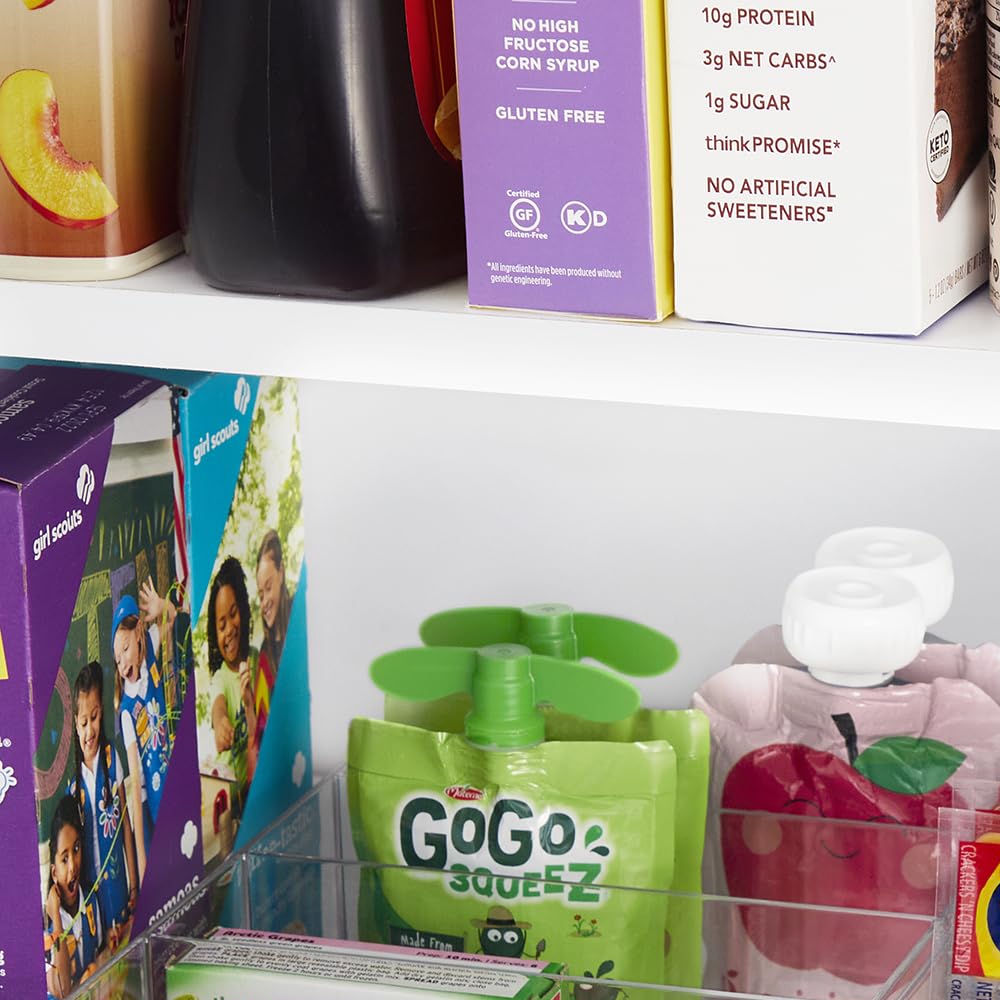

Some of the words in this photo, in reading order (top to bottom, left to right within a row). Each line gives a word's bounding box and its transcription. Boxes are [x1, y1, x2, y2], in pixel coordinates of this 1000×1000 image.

[512, 18, 536, 32] NO
[538, 19, 579, 33] HIGH
[702, 7, 732, 29] 10g
[737, 9, 815, 28] PROTEIN
[504, 37, 589, 53] FRUCTOSE
[496, 56, 542, 71] CORN
[546, 58, 599, 73] SYRUP
[703, 50, 724, 70] 3g
[729, 51, 764, 68] NET
[705, 92, 725, 112] 1g
[729, 93, 790, 112] SUGAR
[495, 106, 559, 123] GLUTEN
[563, 109, 605, 124] FREE
[507, 189, 540, 198] Certified
[707, 177, 735, 194] NO
[740, 179, 836, 199] ARTIFICIAL
[504, 230, 548, 239] Gluten-Free
[193, 432, 211, 465] girl
[210, 418, 240, 450] scouts
[32, 527, 53, 561] girl
[51, 508, 83, 545] scouts
[400, 797, 575, 869] GoGo
